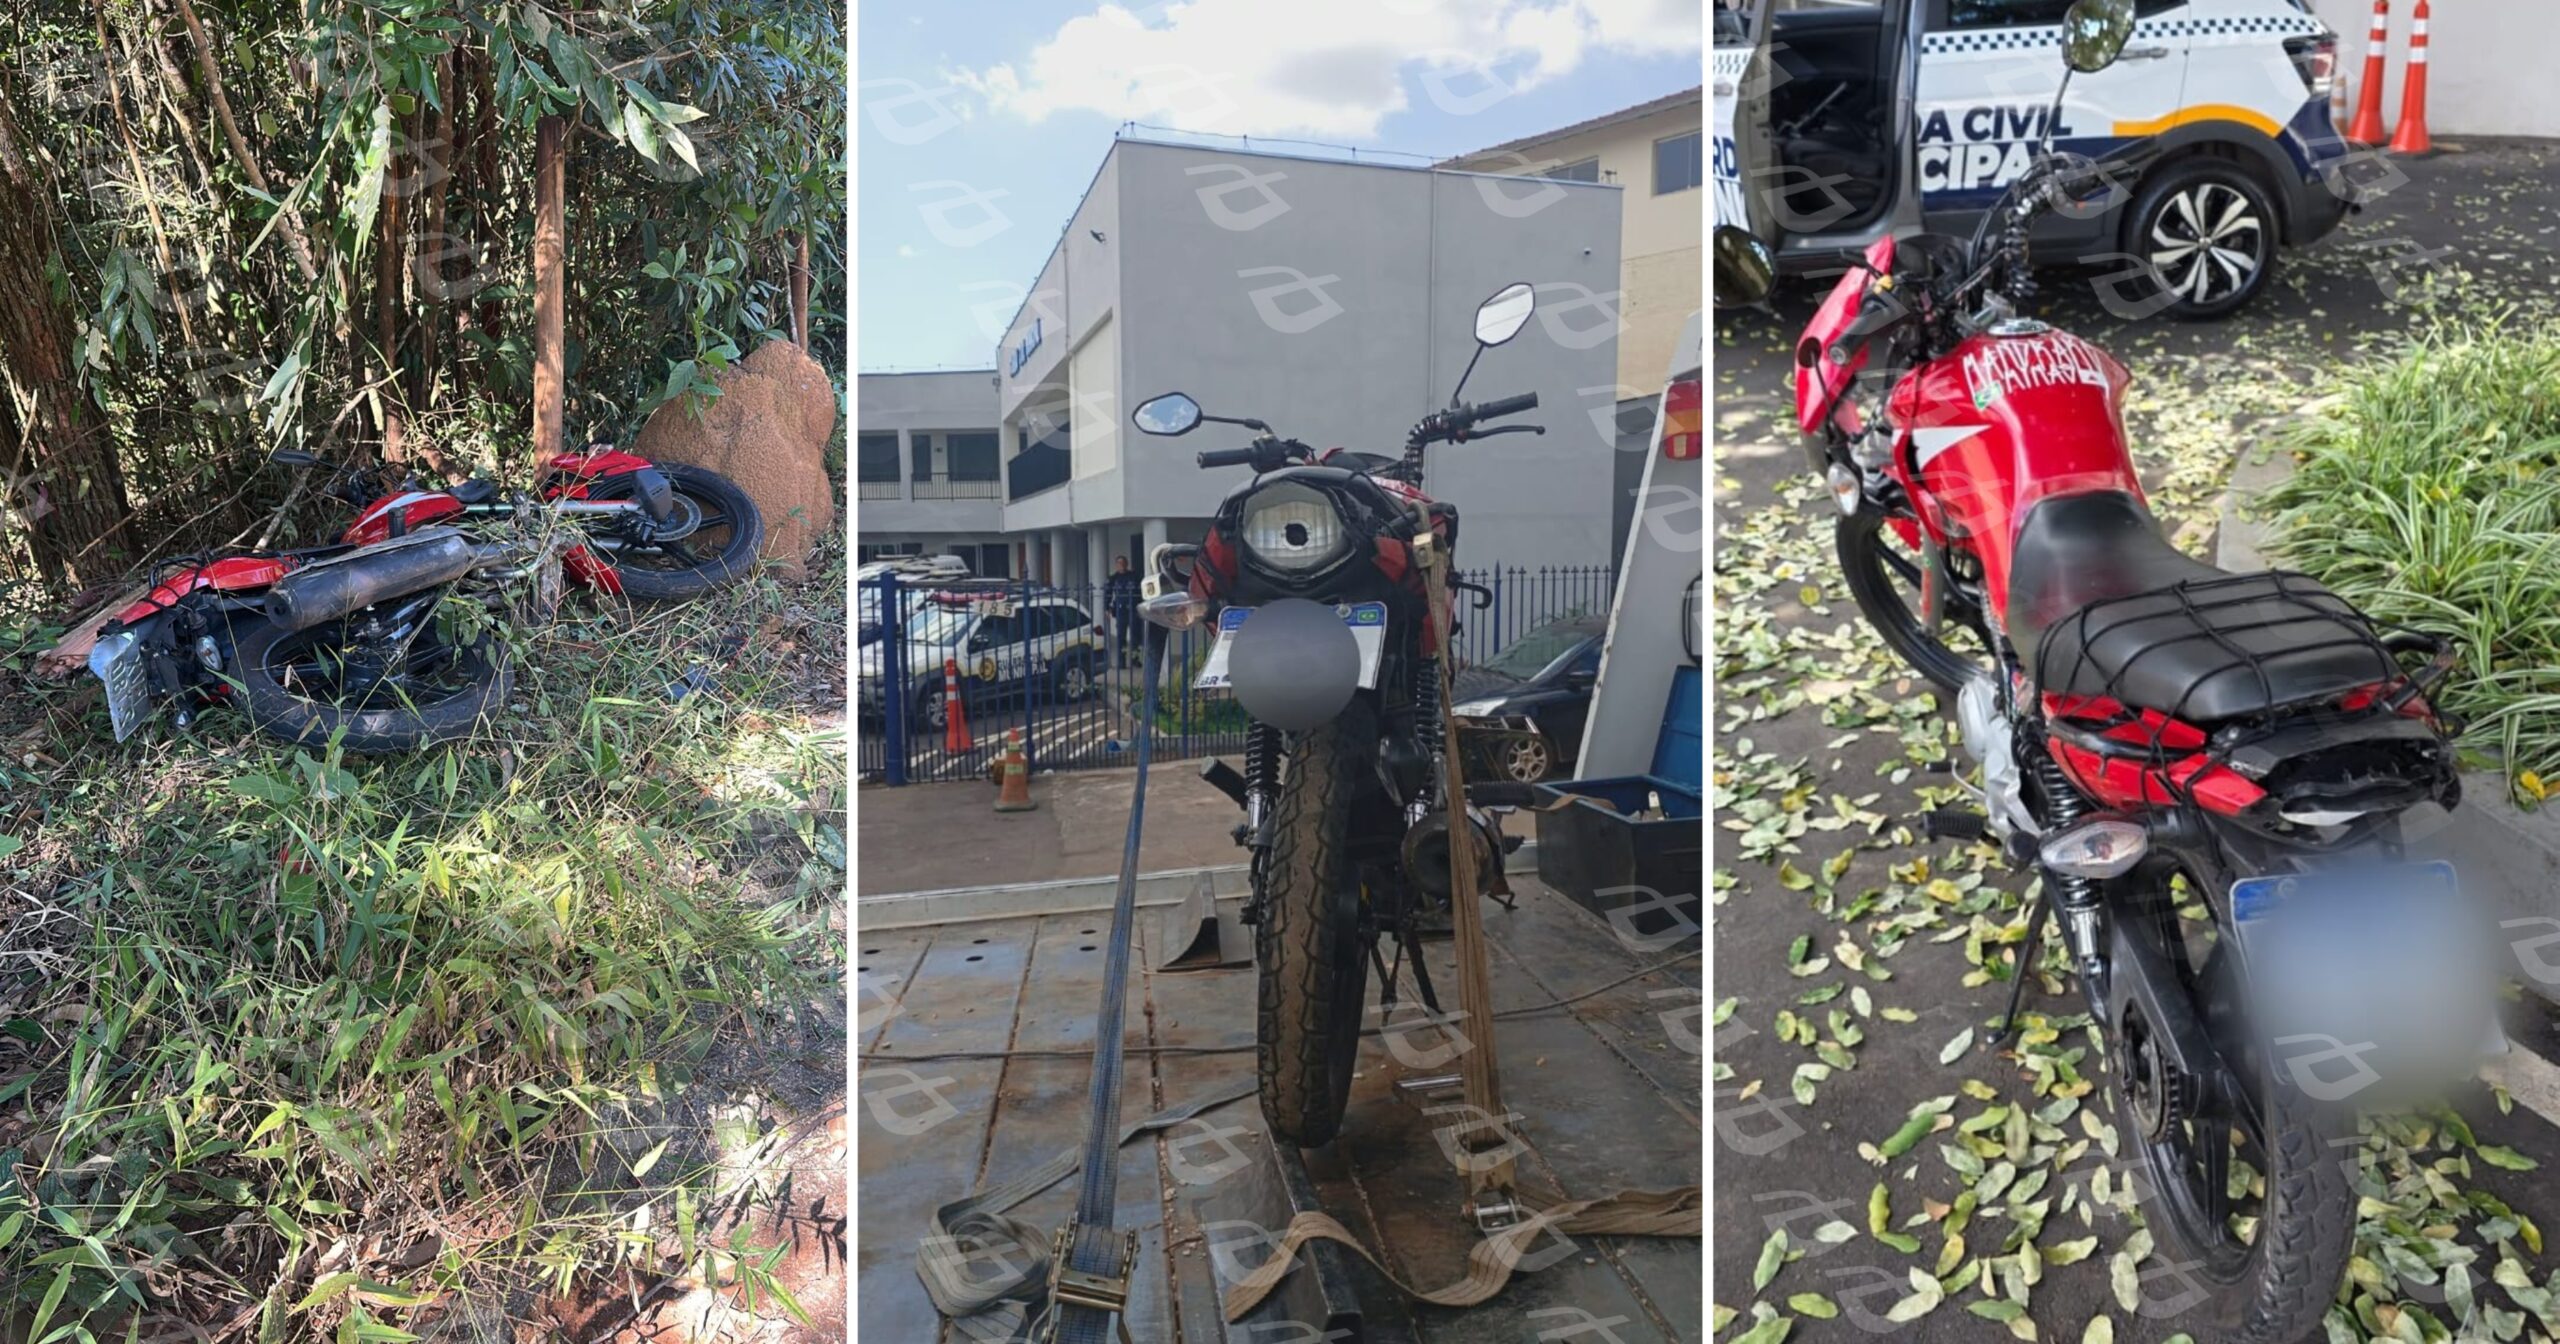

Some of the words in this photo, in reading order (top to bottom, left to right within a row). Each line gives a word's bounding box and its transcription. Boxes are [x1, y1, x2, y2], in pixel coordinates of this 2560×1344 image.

[1914, 109, 1953, 143] A
[1963, 105, 2073, 142] CIVIL
[979, 602, 1013, 616] 185
